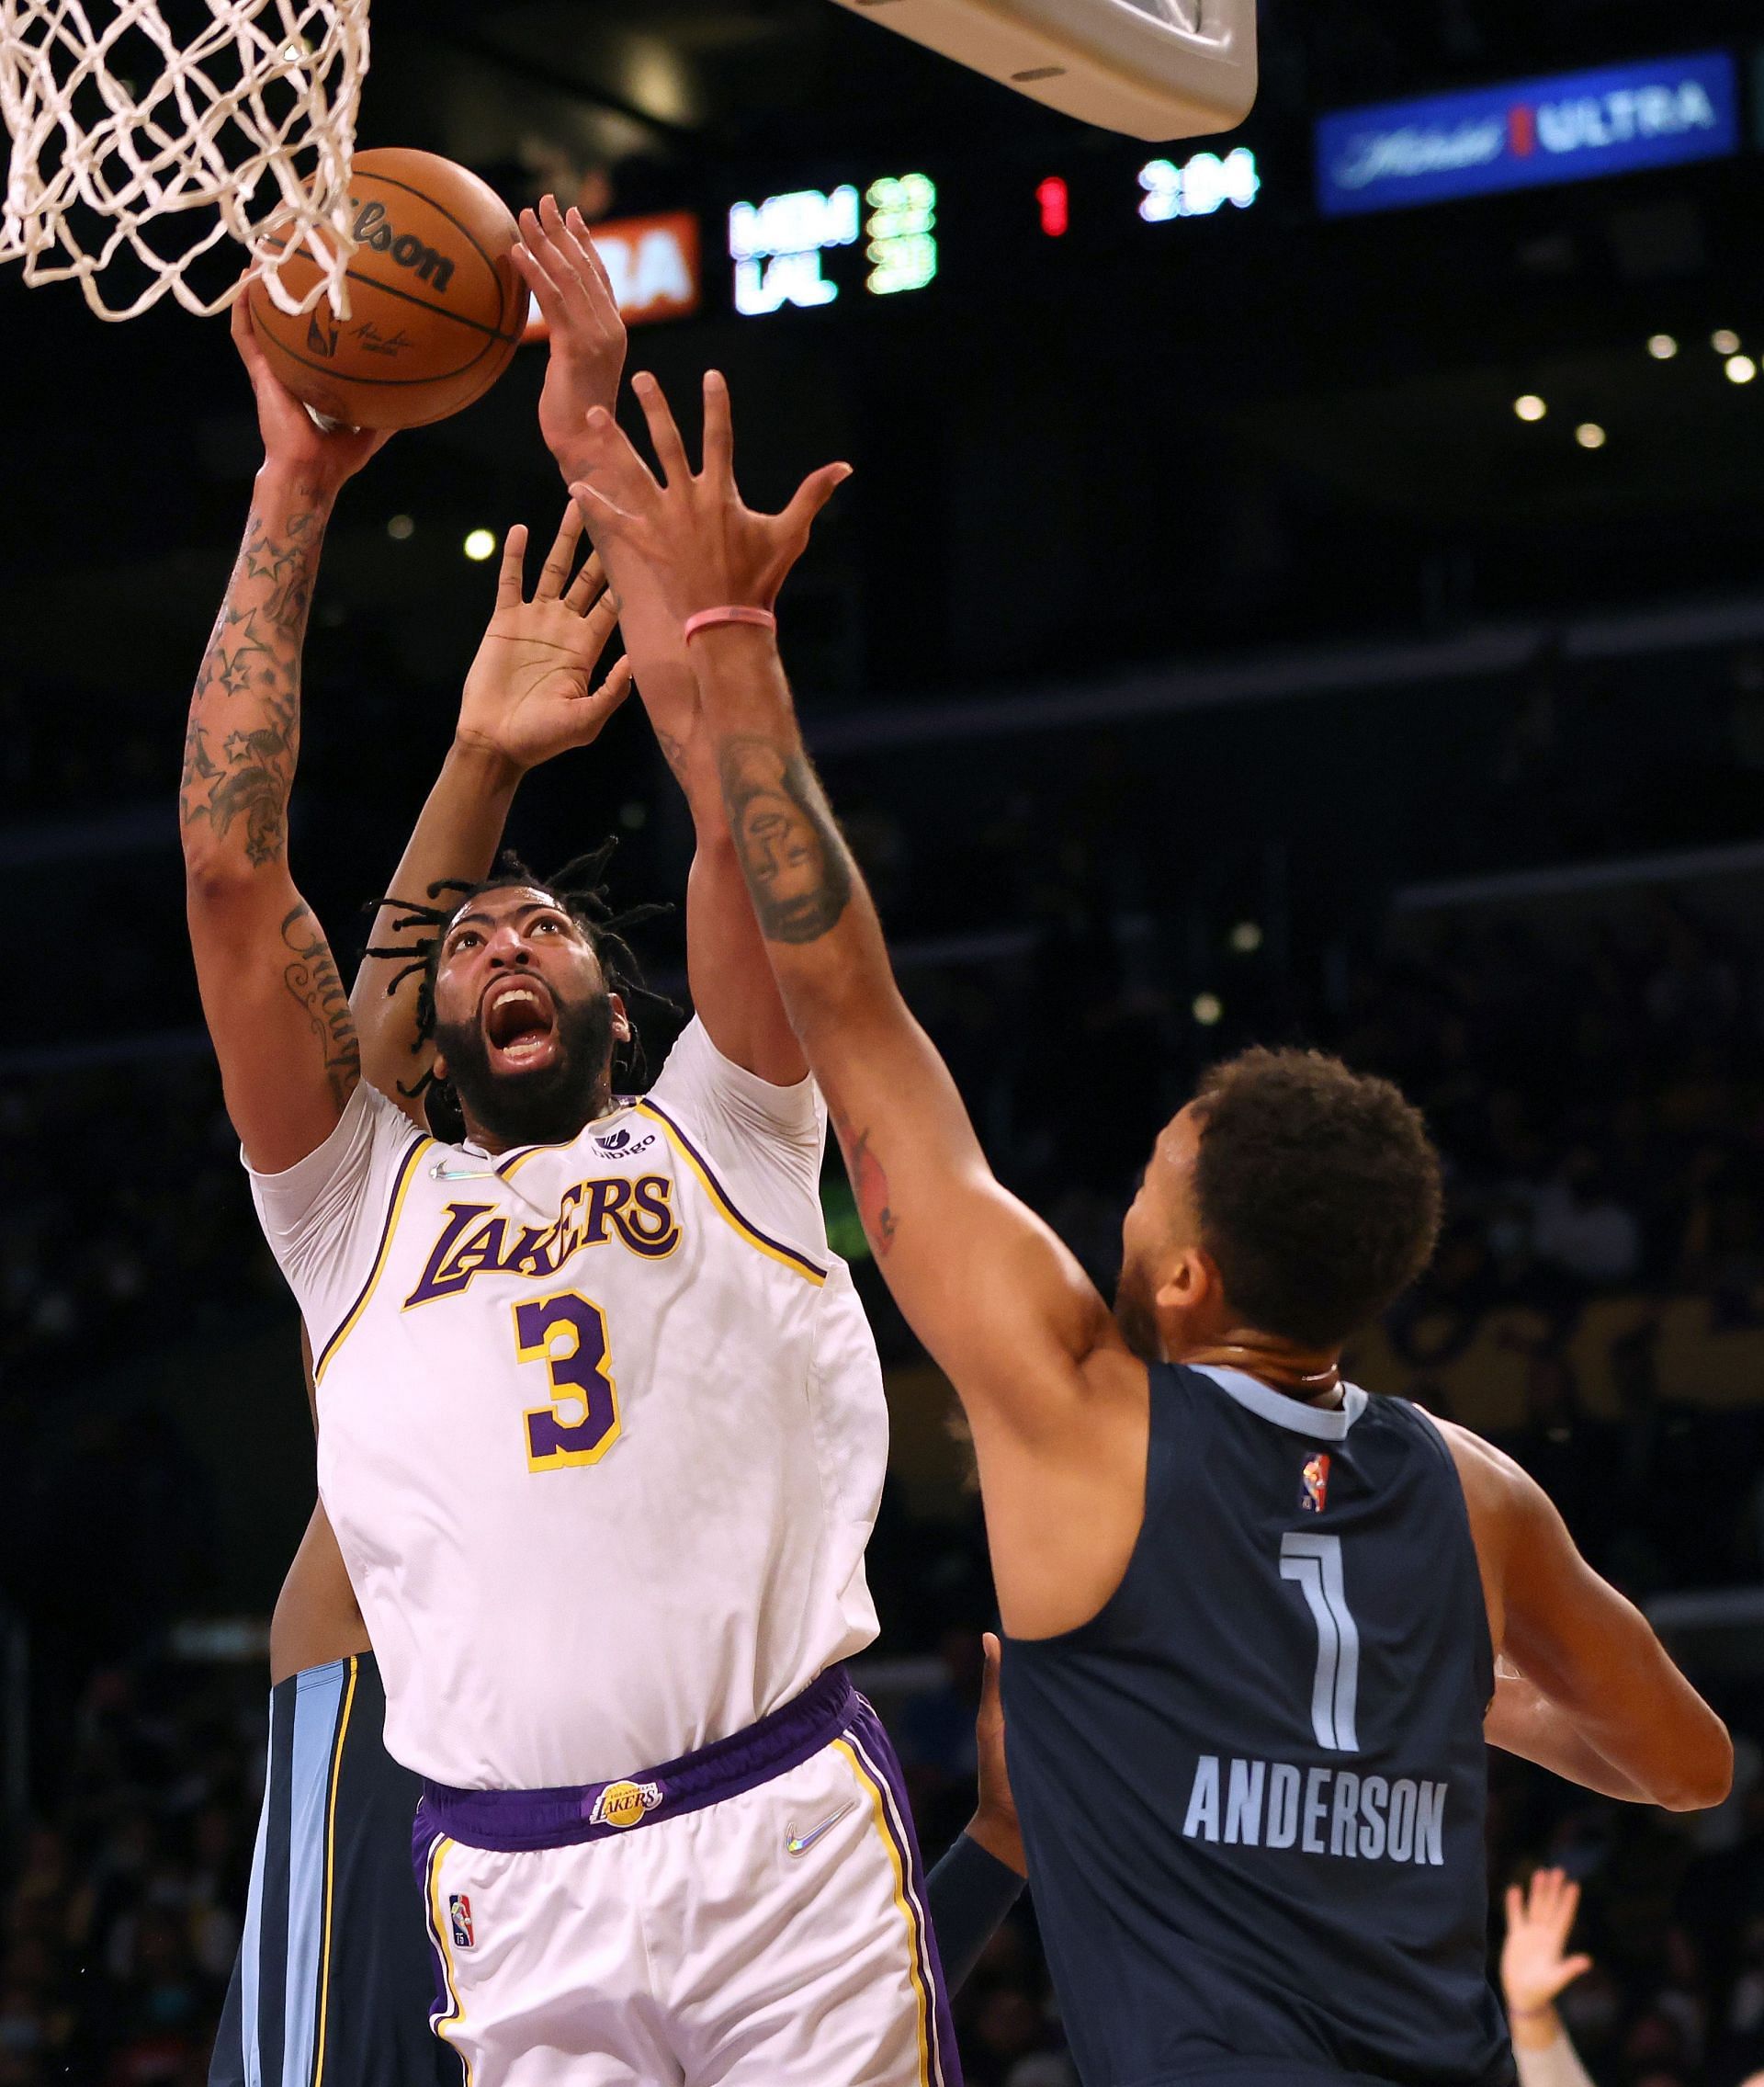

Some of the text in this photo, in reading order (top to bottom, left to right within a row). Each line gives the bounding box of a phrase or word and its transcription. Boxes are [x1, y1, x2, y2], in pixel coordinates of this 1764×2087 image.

[1537, 80, 1717, 154] ULTRA
[1035, 176, 1069, 236] 1
[400, 1176, 683, 1312] LAKERS
[511, 1288, 621, 1473] 3
[1280, 1532, 1360, 1752] 1
[590, 1789, 662, 1823] LAKERS
[1182, 1754, 1448, 1866] ANDERSON
